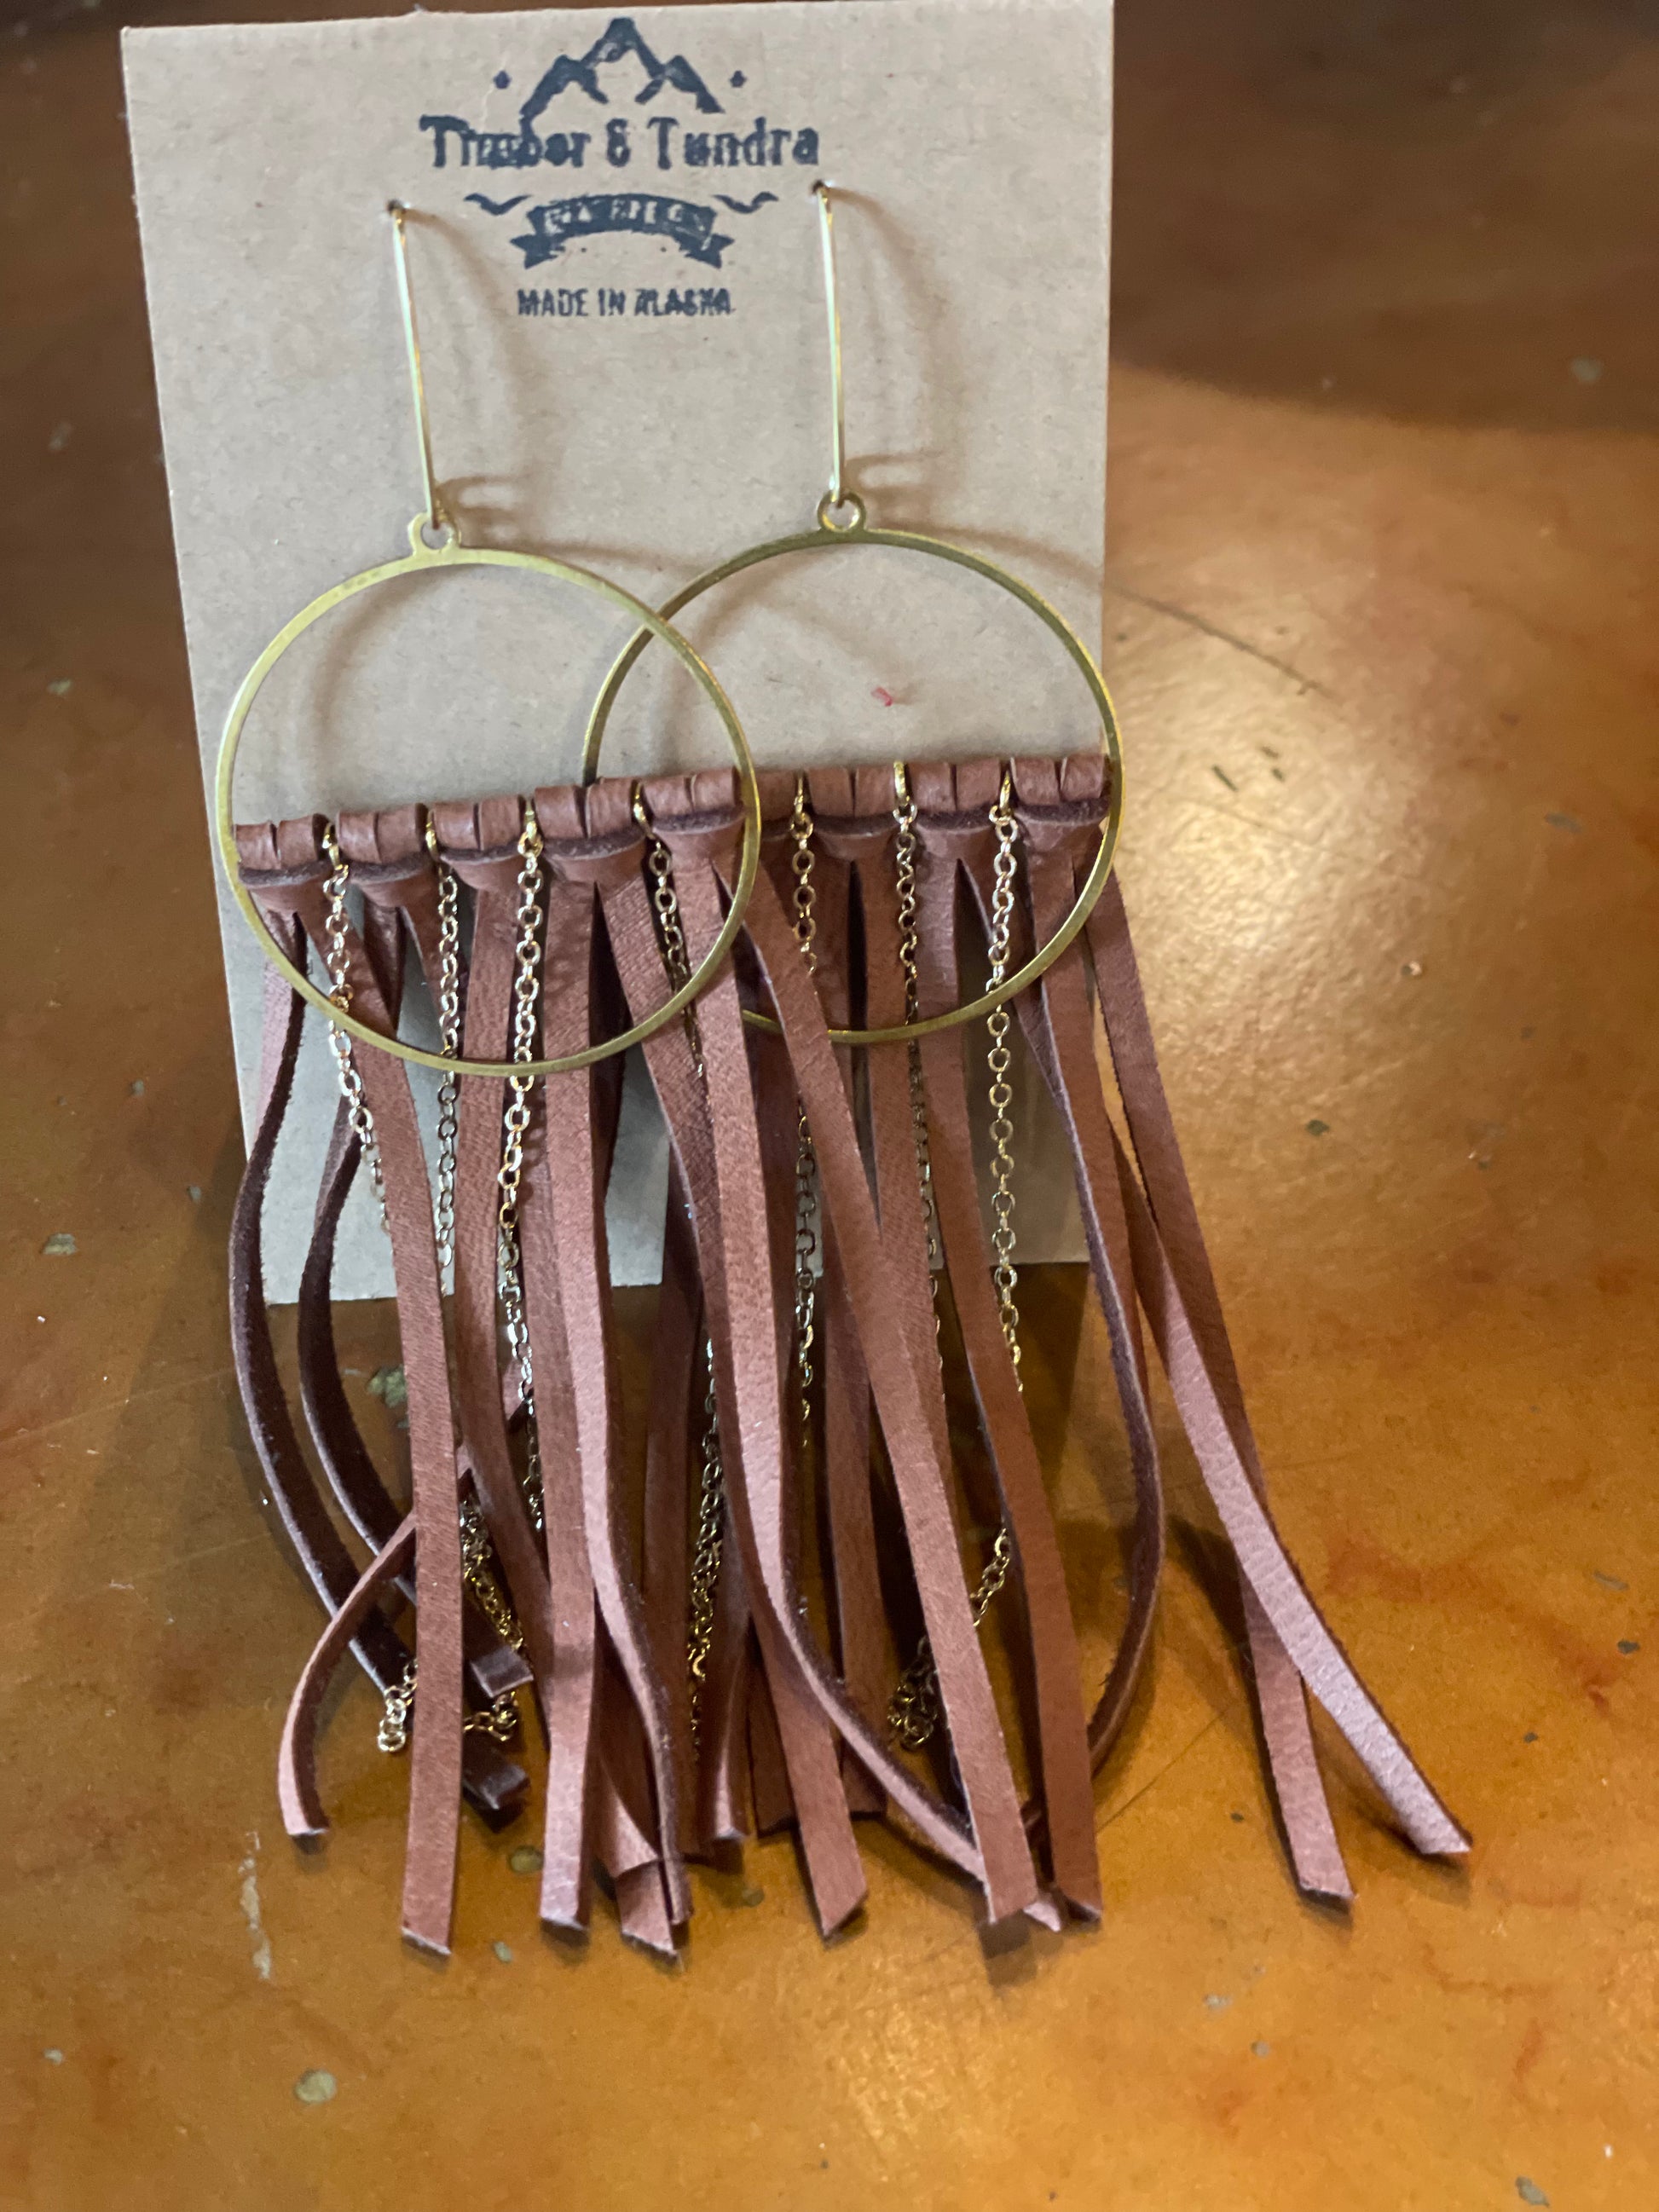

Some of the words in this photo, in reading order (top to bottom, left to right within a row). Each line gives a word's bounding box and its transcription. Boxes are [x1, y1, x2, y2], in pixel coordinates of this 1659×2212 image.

[647, 116, 819, 170] Tundra
[517, 288, 588, 316] MADE
[598, 288, 626, 316] IN
